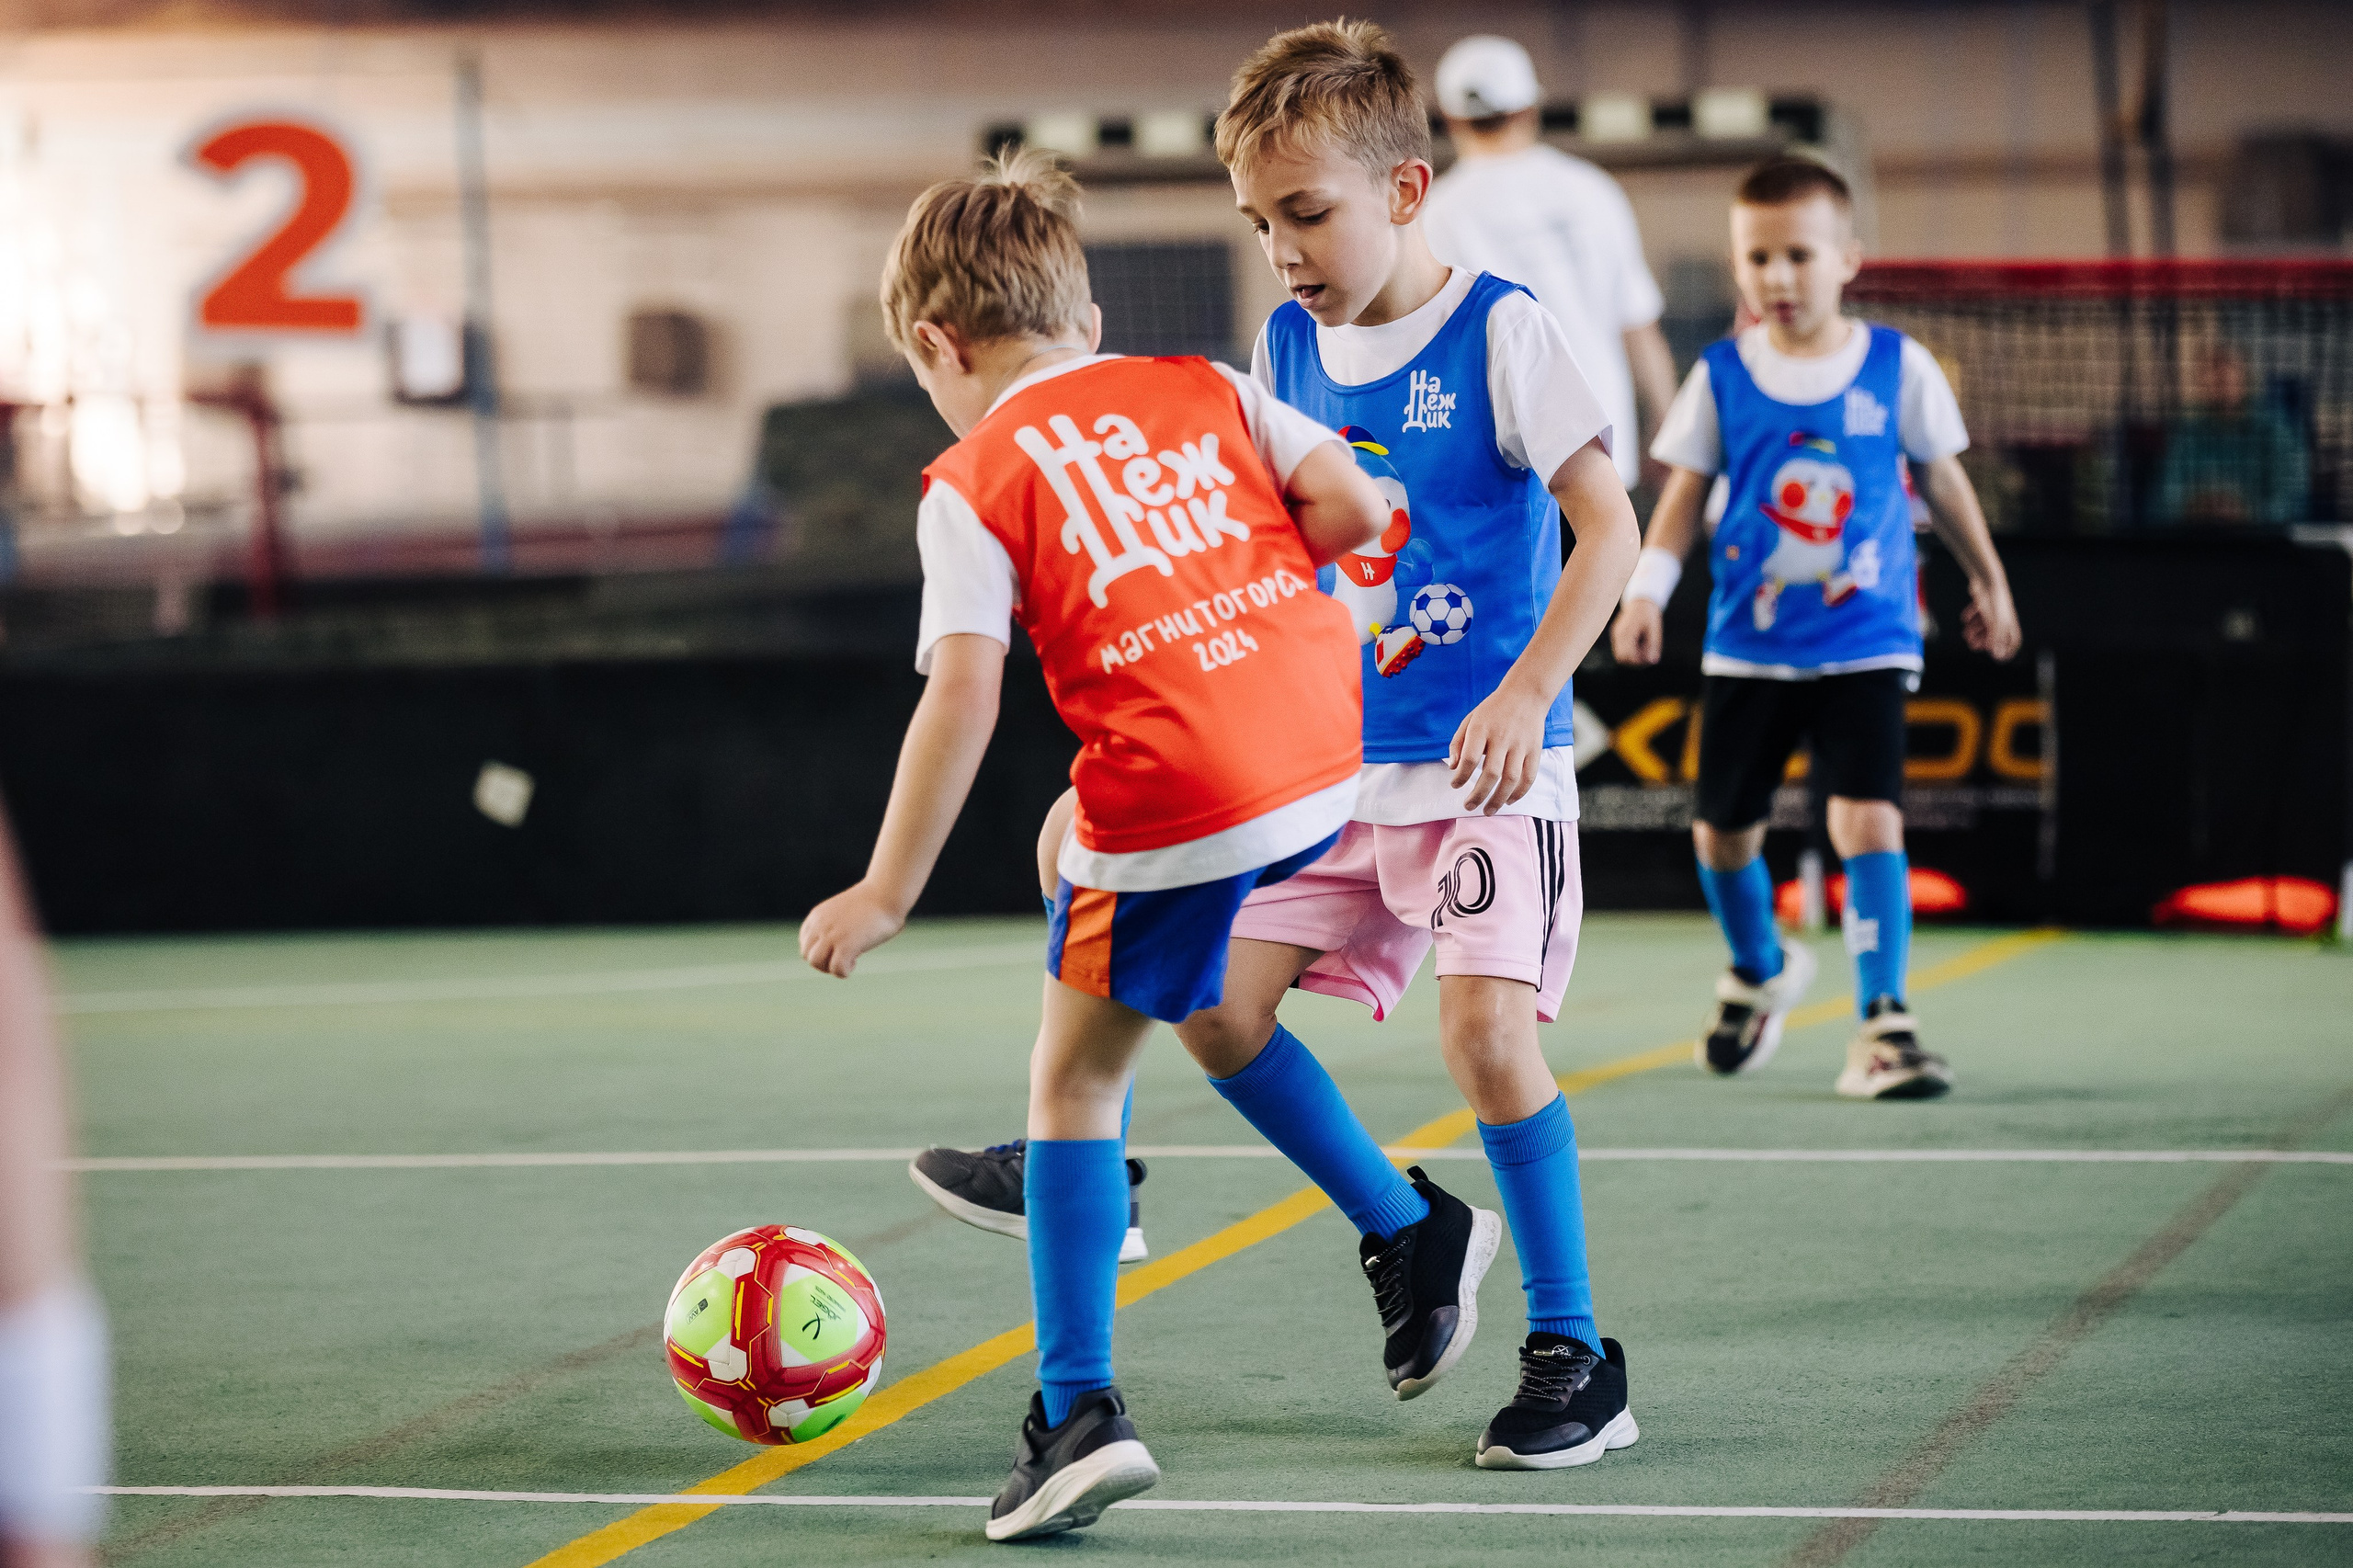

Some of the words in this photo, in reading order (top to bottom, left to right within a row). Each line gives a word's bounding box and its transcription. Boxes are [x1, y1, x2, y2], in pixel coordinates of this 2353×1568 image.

[197, 121, 361, 329] 2
[1192, 628, 1259, 672] 2024
[1431, 846, 1496, 931] 10
